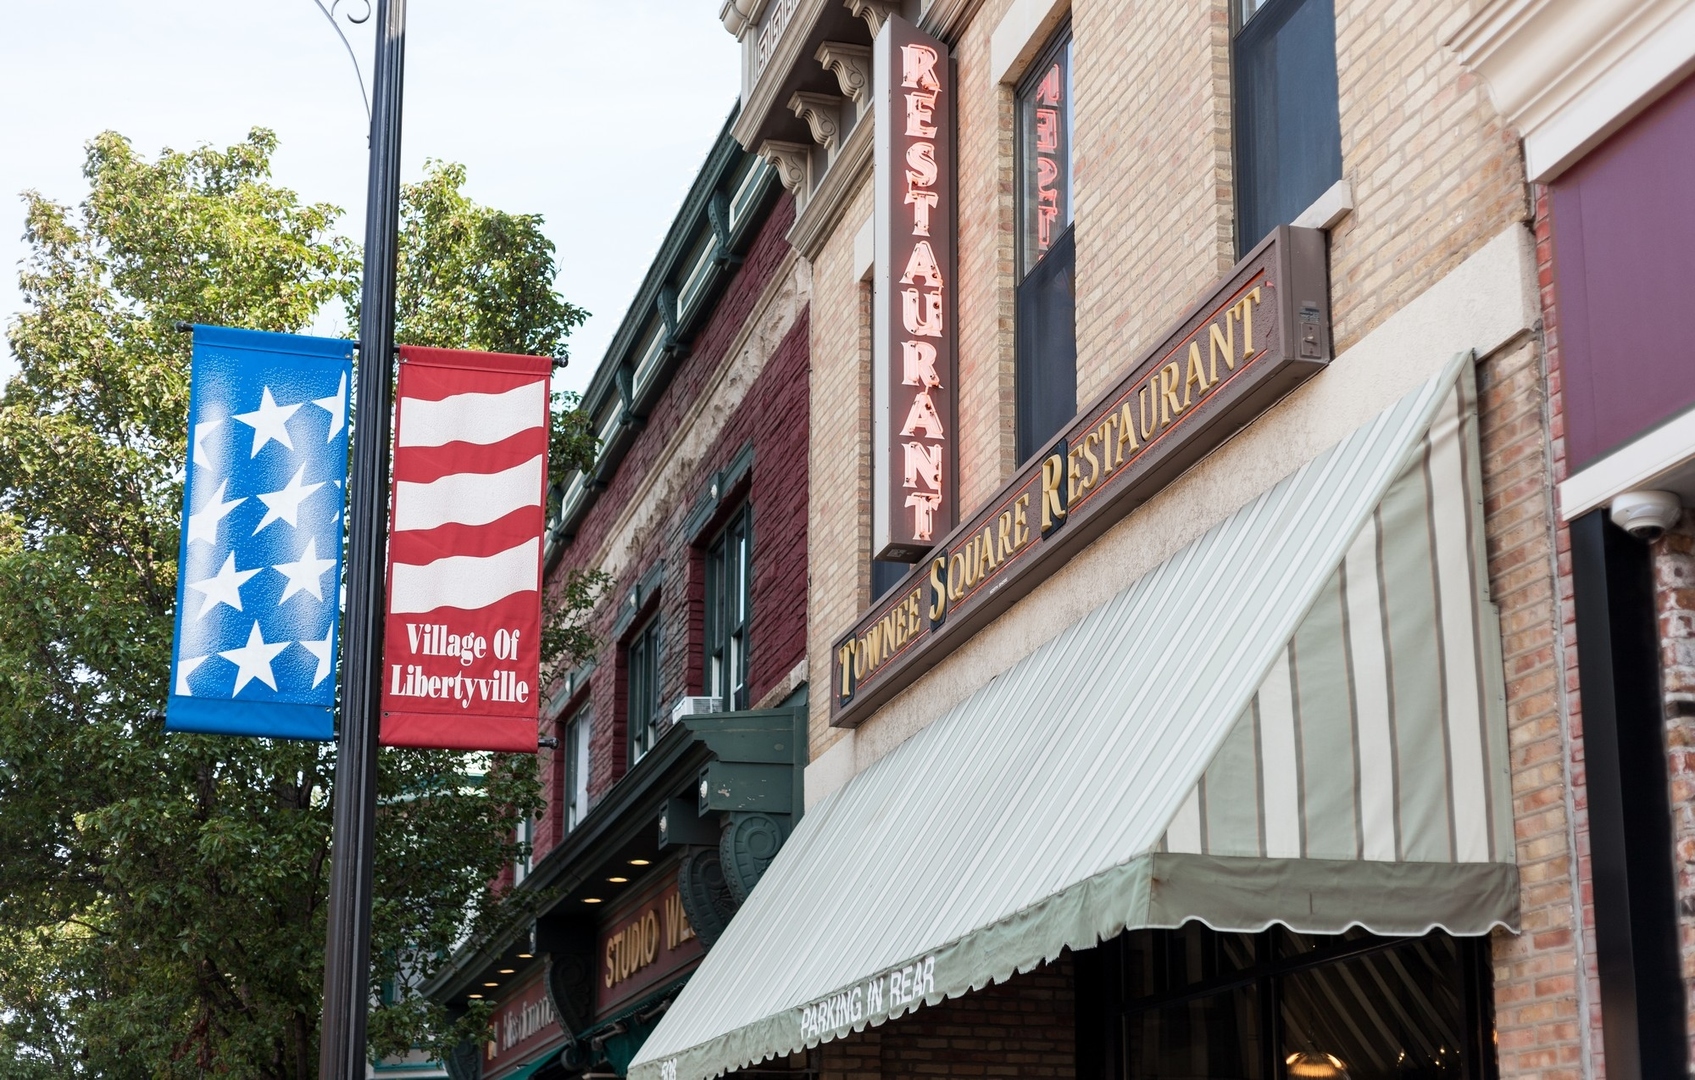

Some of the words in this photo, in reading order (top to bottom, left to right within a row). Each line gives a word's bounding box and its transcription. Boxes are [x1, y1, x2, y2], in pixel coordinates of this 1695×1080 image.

[900, 43, 943, 542] RESTAURANT
[838, 589, 921, 699] TOWNEE
[929, 493, 1030, 622] SQUARE
[1041, 286, 1261, 532] RESTAURANT
[389, 664, 530, 709] Libertyville
[405, 623, 487, 667] Village
[493, 628, 520, 661] Of
[605, 908, 661, 989] STUDIO
[665, 890, 697, 951] WE
[800, 988, 862, 1041] PARKING
[866, 976, 885, 1016] IN
[889, 955, 936, 1009] REAR
